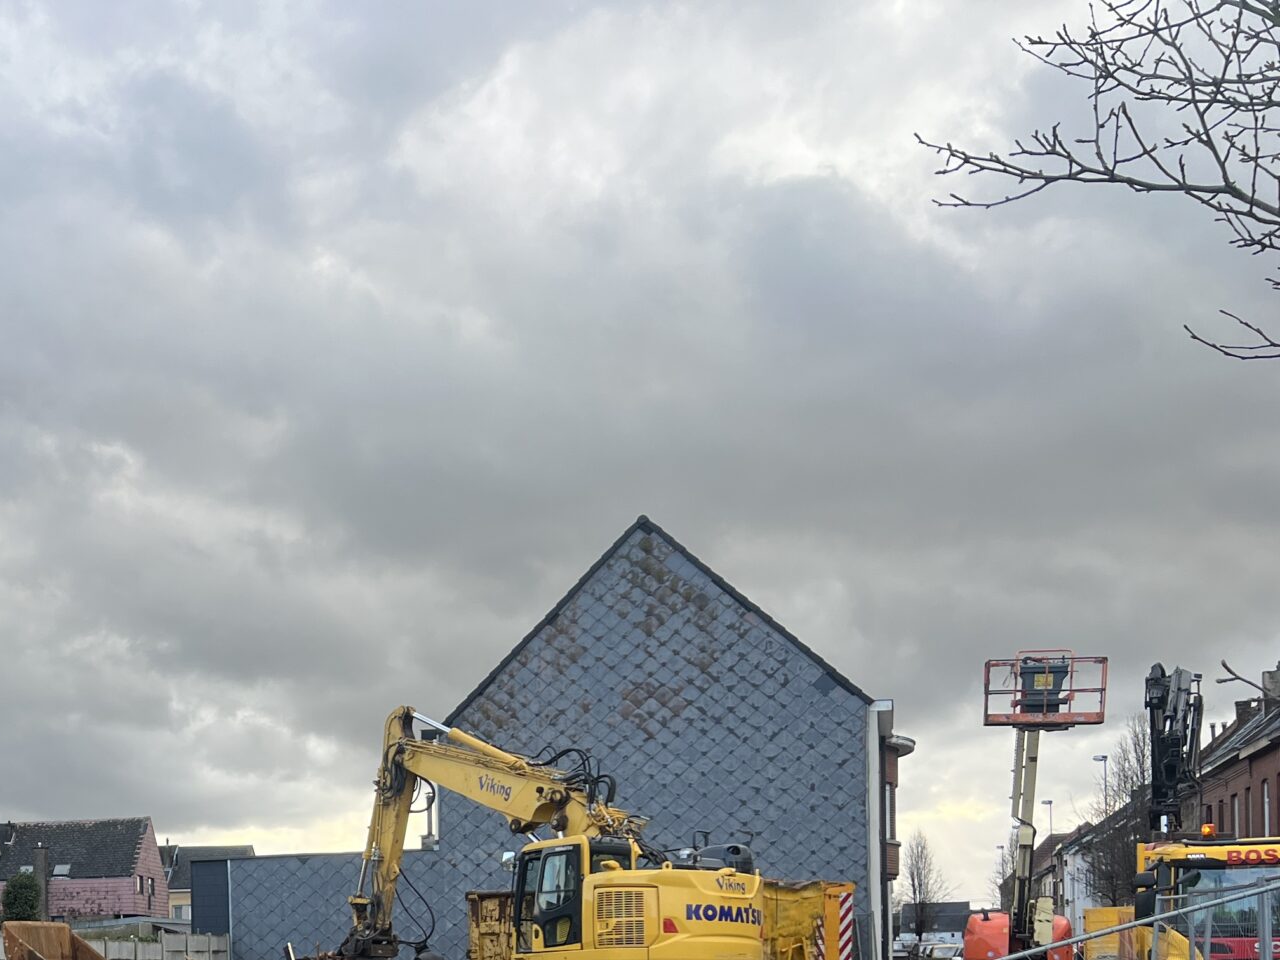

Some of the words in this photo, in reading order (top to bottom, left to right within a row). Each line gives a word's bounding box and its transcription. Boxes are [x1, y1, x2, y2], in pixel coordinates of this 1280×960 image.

[478, 774, 512, 802] Viking
[716, 875, 746, 895] Viking
[686, 903, 762, 926] KOMATSU
